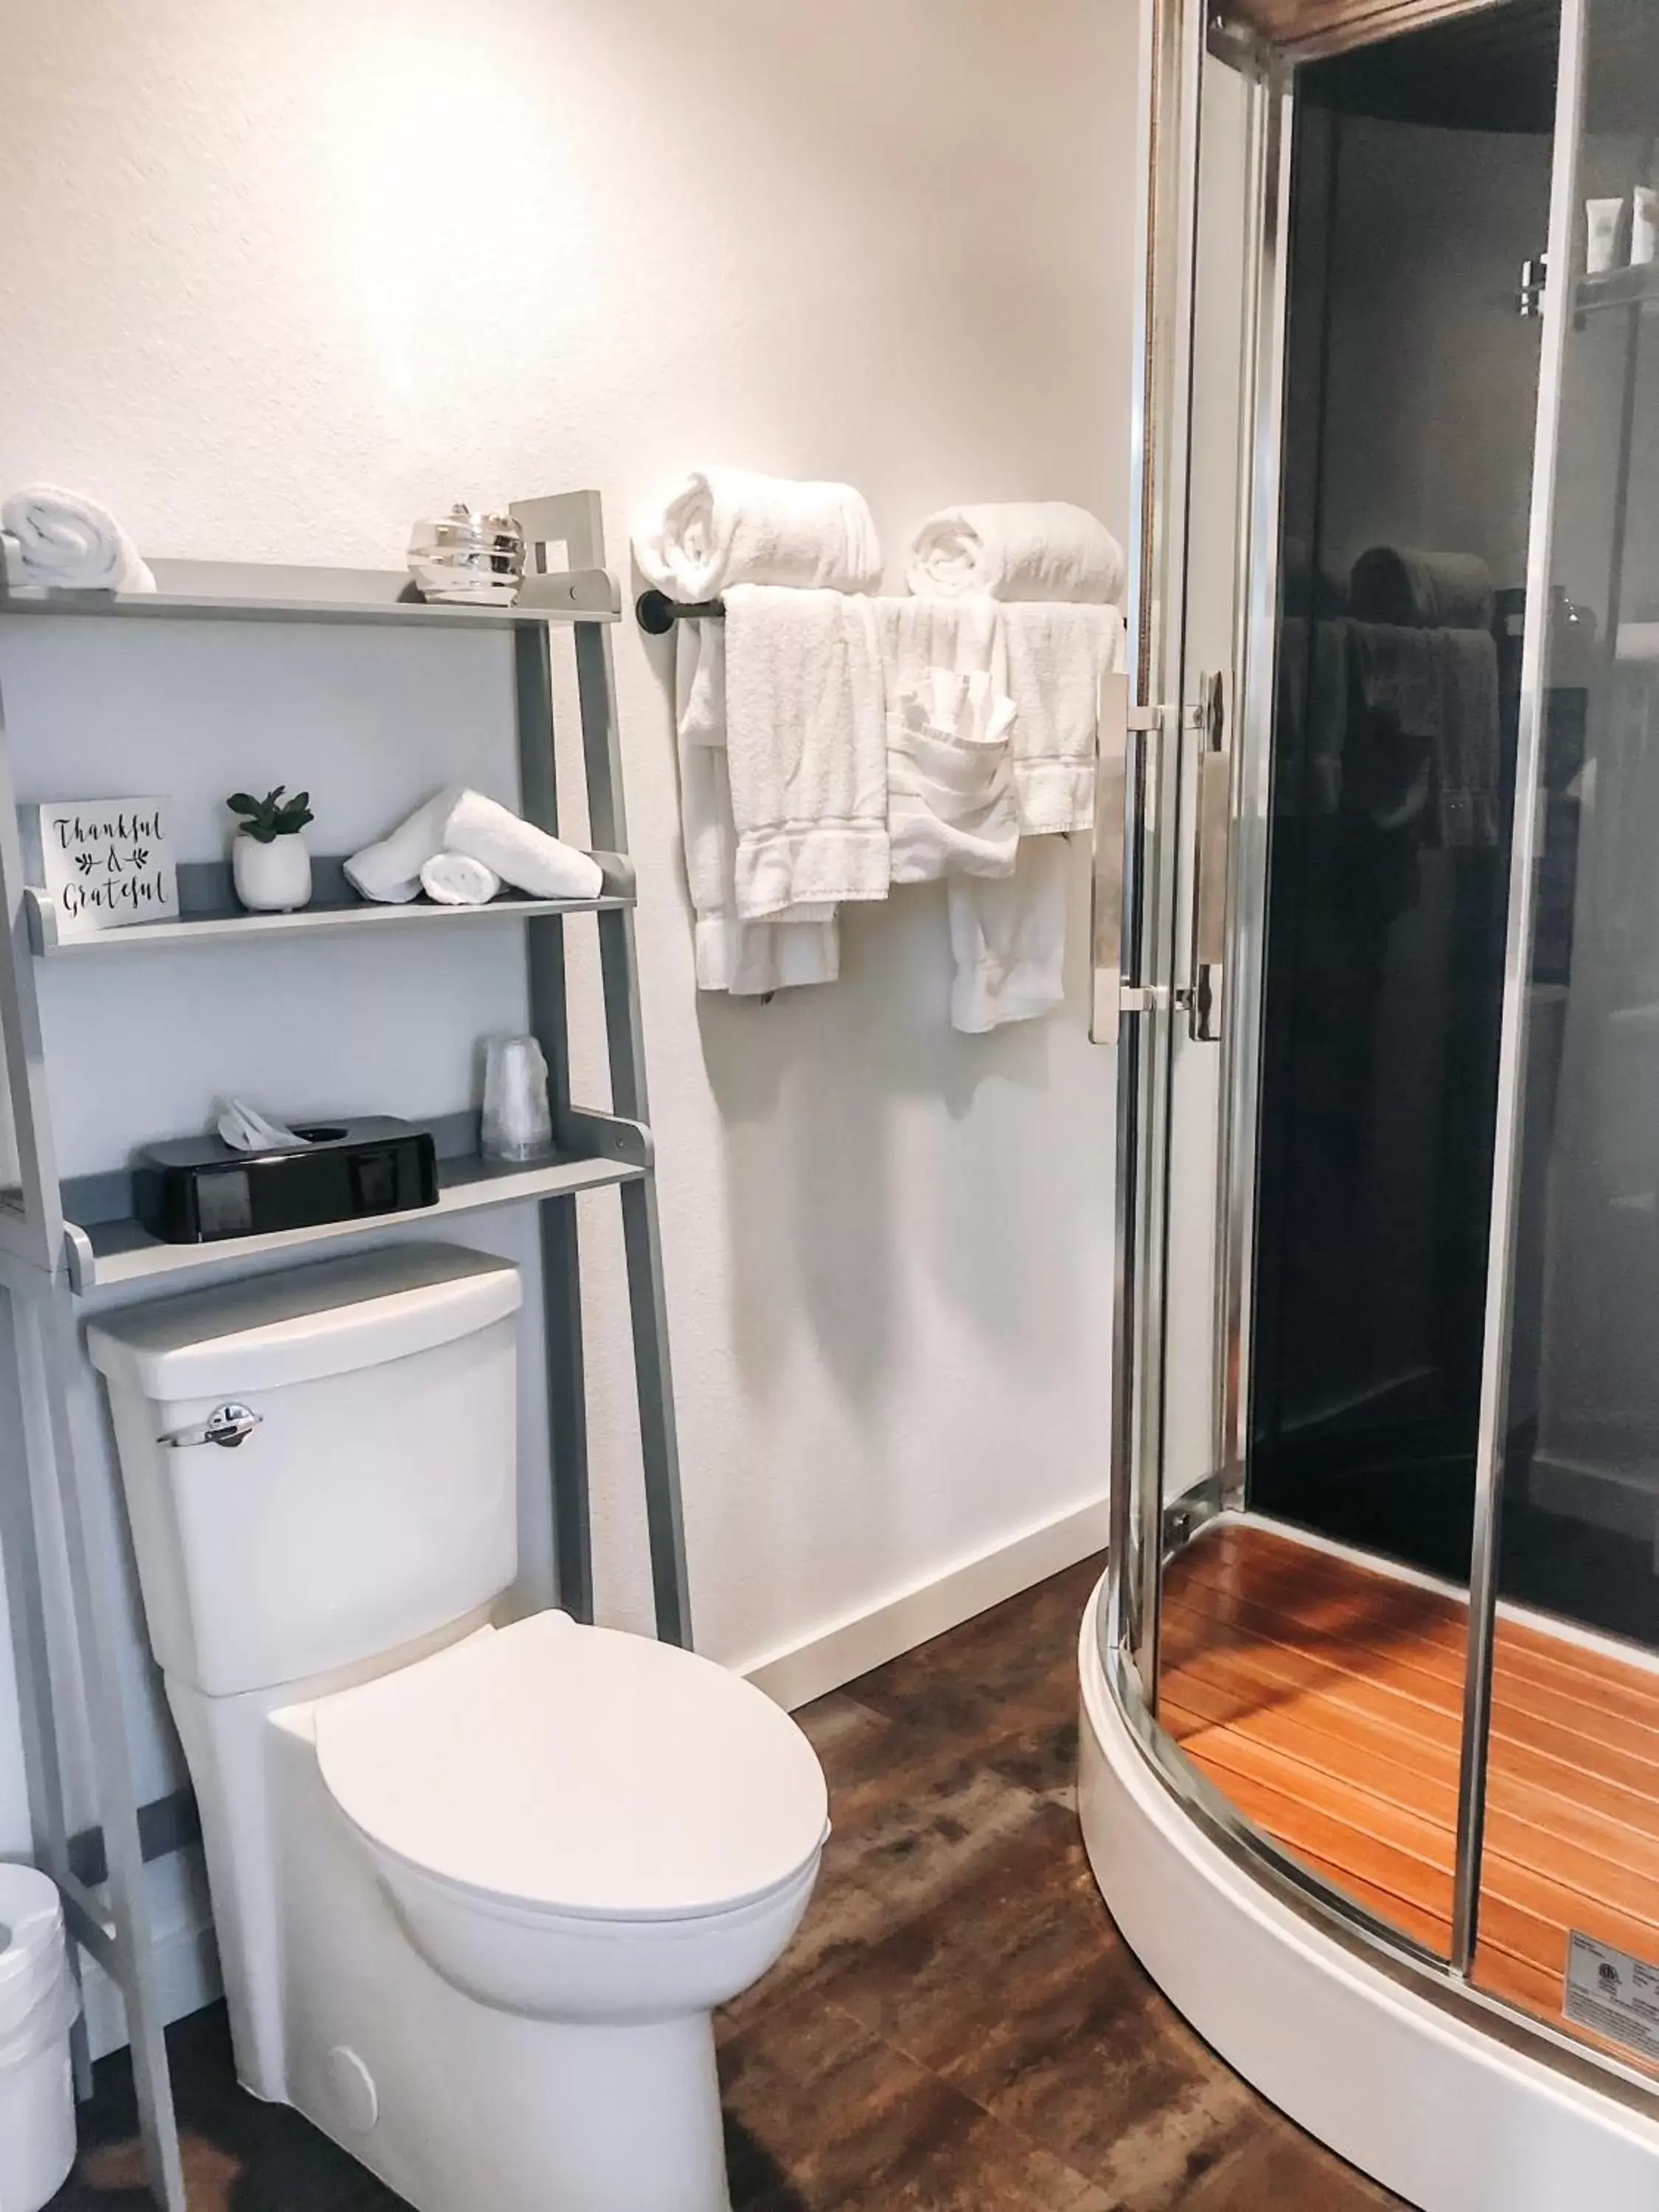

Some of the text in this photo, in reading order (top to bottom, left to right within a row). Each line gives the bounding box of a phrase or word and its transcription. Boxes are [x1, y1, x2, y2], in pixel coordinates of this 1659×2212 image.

[53, 812, 164, 848] Thankful
[107, 844, 122, 872] &
[63, 872, 167, 917] Grateful
